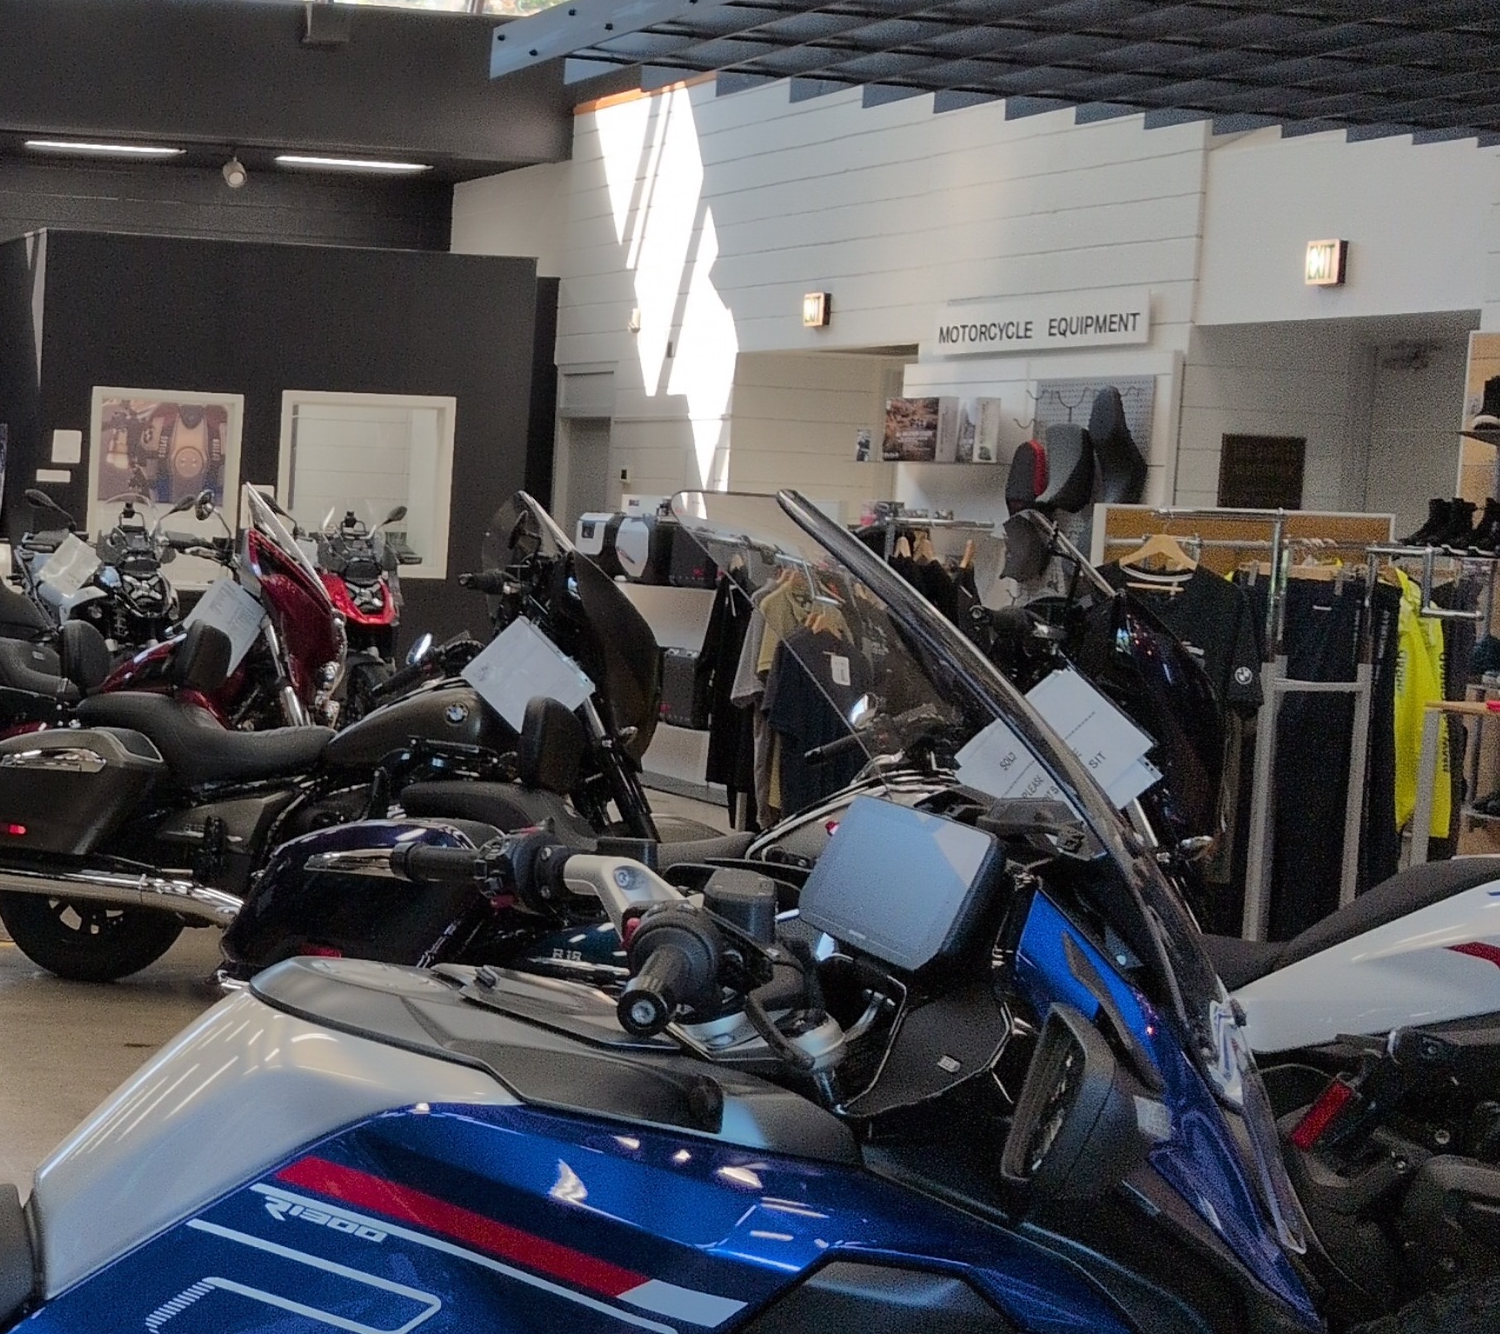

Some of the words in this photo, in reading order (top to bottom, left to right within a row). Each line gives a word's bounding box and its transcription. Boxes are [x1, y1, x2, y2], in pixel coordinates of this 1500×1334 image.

[1307, 243, 1336, 281] EXIT
[938, 320, 1033, 344] MOTORCYCLE
[1047, 312, 1141, 338] EQUIPMENT
[999, 751, 1018, 771] SOLD
[1088, 750, 1107, 769] SIT
[1021, 774, 1045, 799] PLEASE
